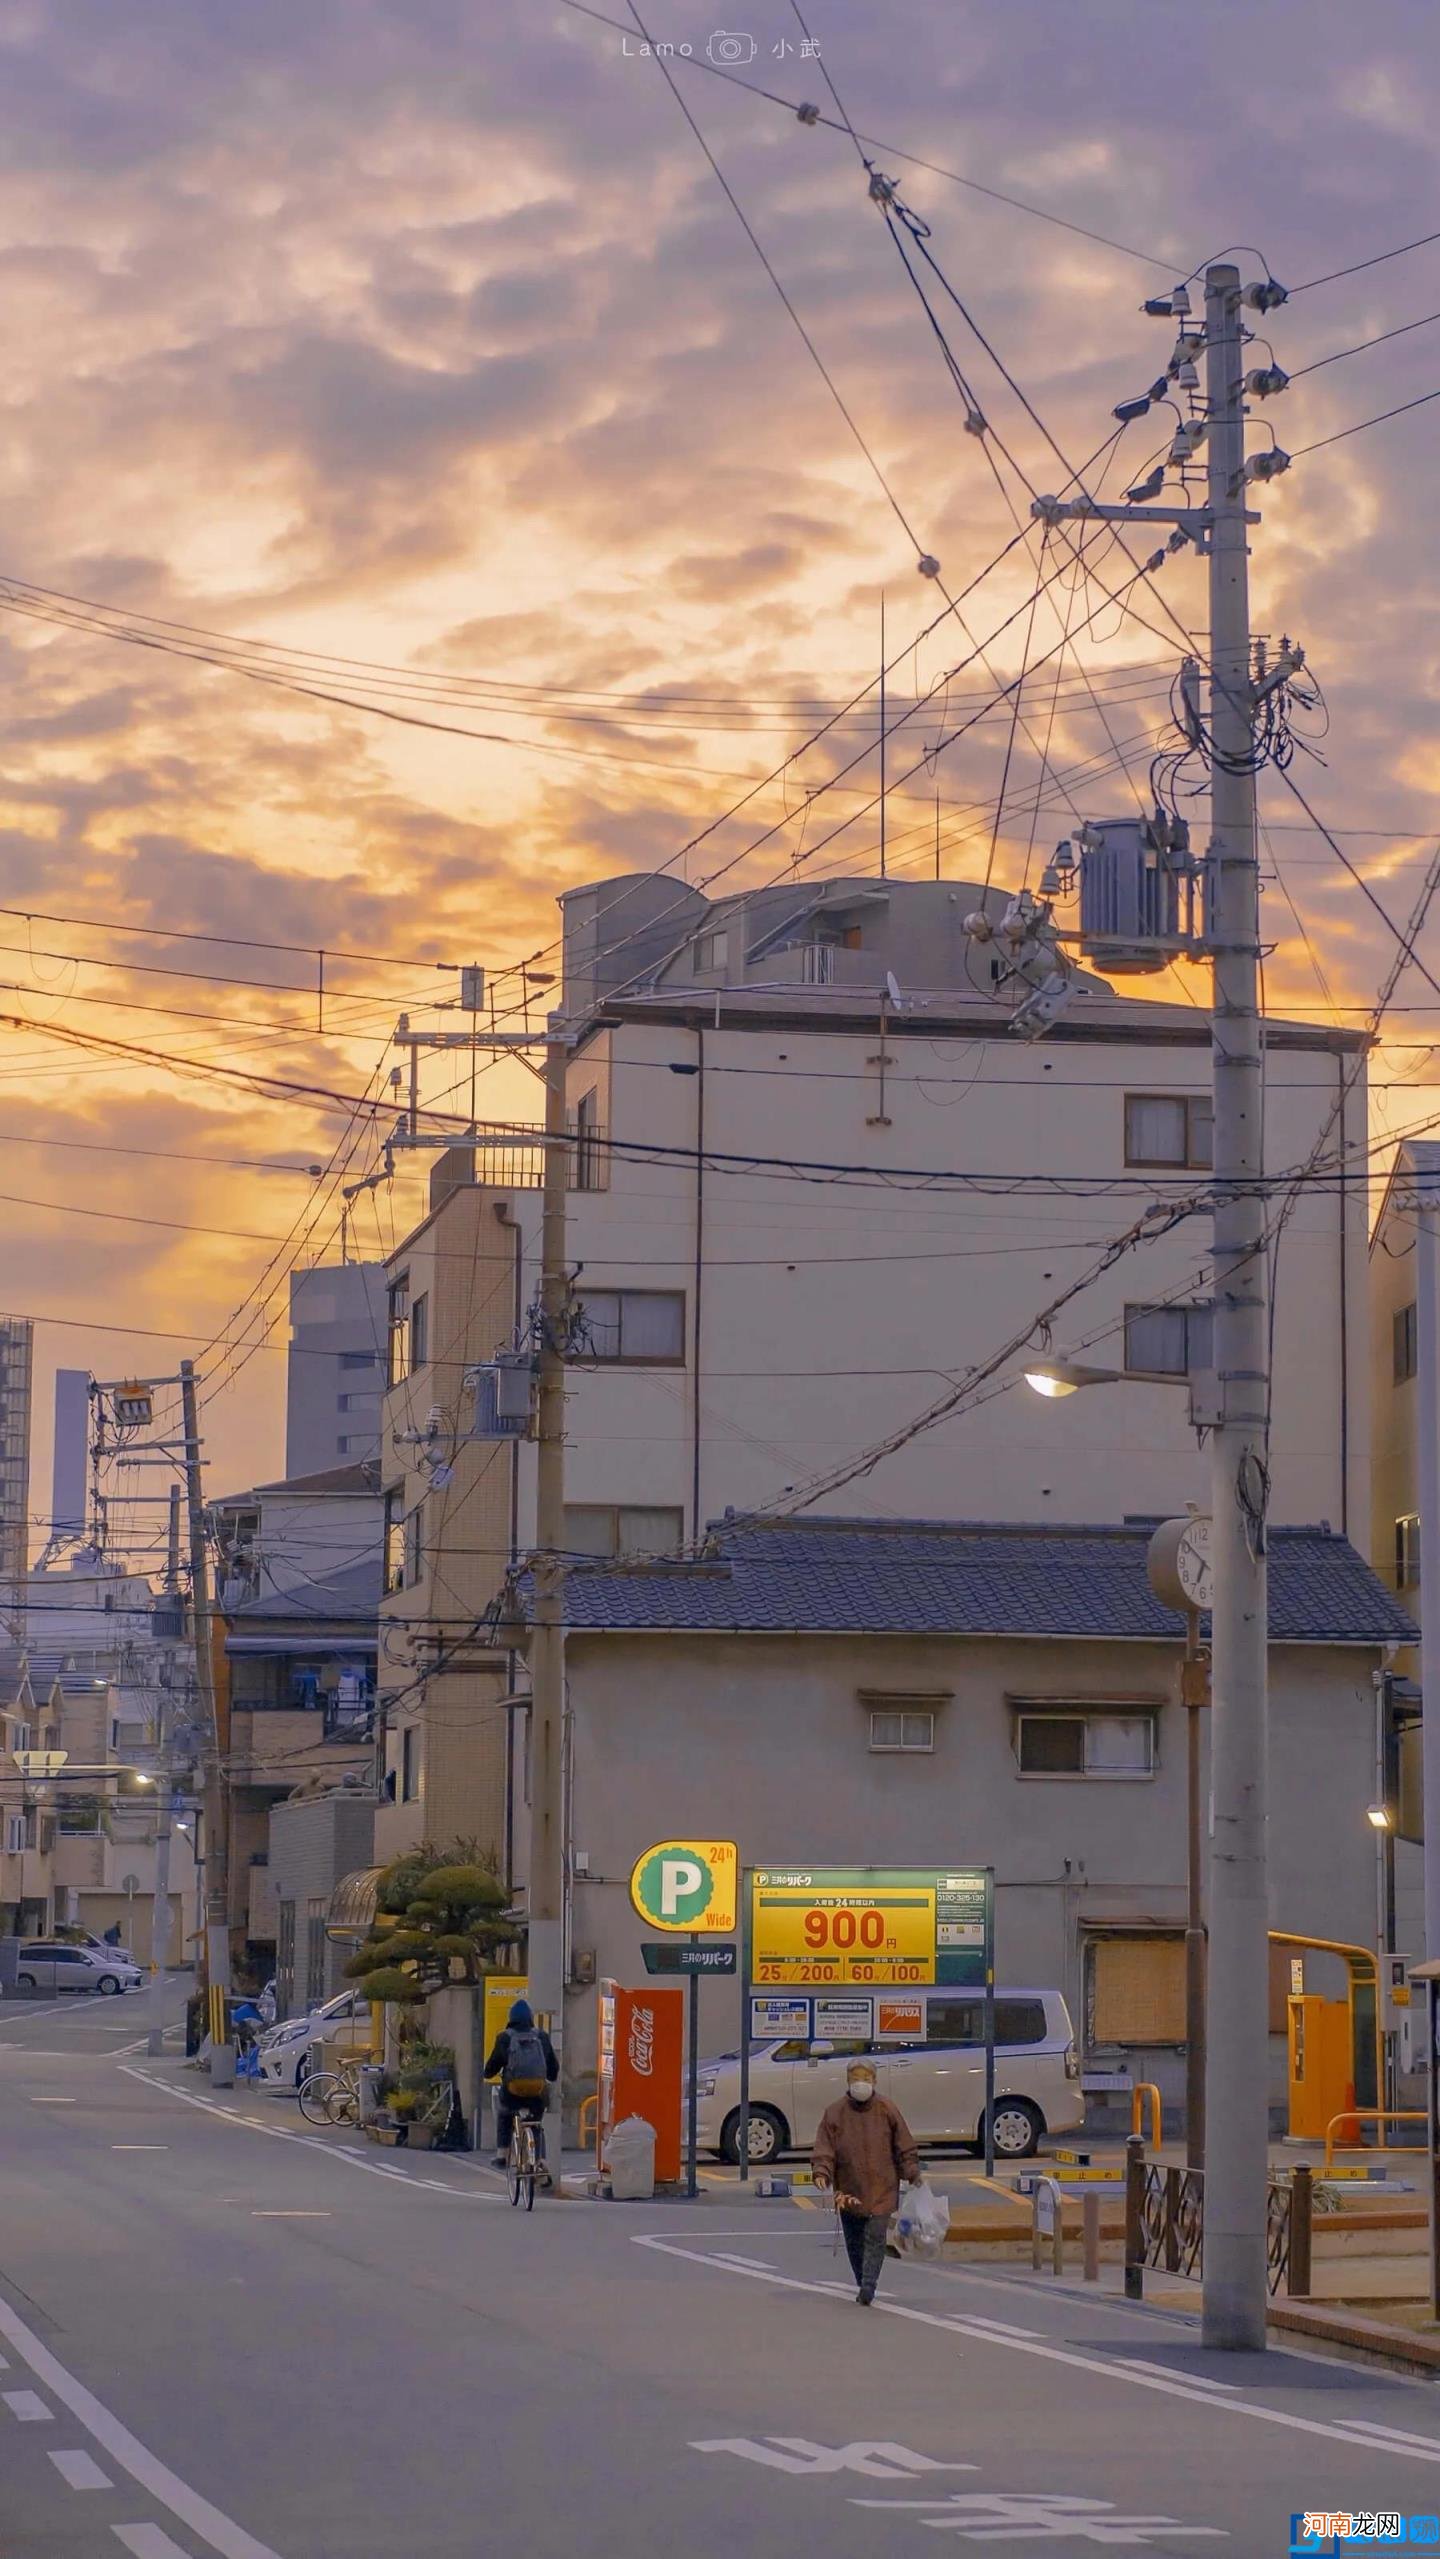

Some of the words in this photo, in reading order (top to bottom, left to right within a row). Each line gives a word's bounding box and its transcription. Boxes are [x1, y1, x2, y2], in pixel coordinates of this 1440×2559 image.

[1179, 1556, 1186, 1569] 9
[1182, 1570, 1190, 1583] 8
[1190, 1582, 1197, 1595] 7
[1199, 1587, 1207, 1600] 6
[710, 1846, 733, 1864] 24h
[661, 1860, 702, 1915] P
[706, 1913, 732, 1927] Wide
[681, 1952, 733, 1966] 三井のリパーク
